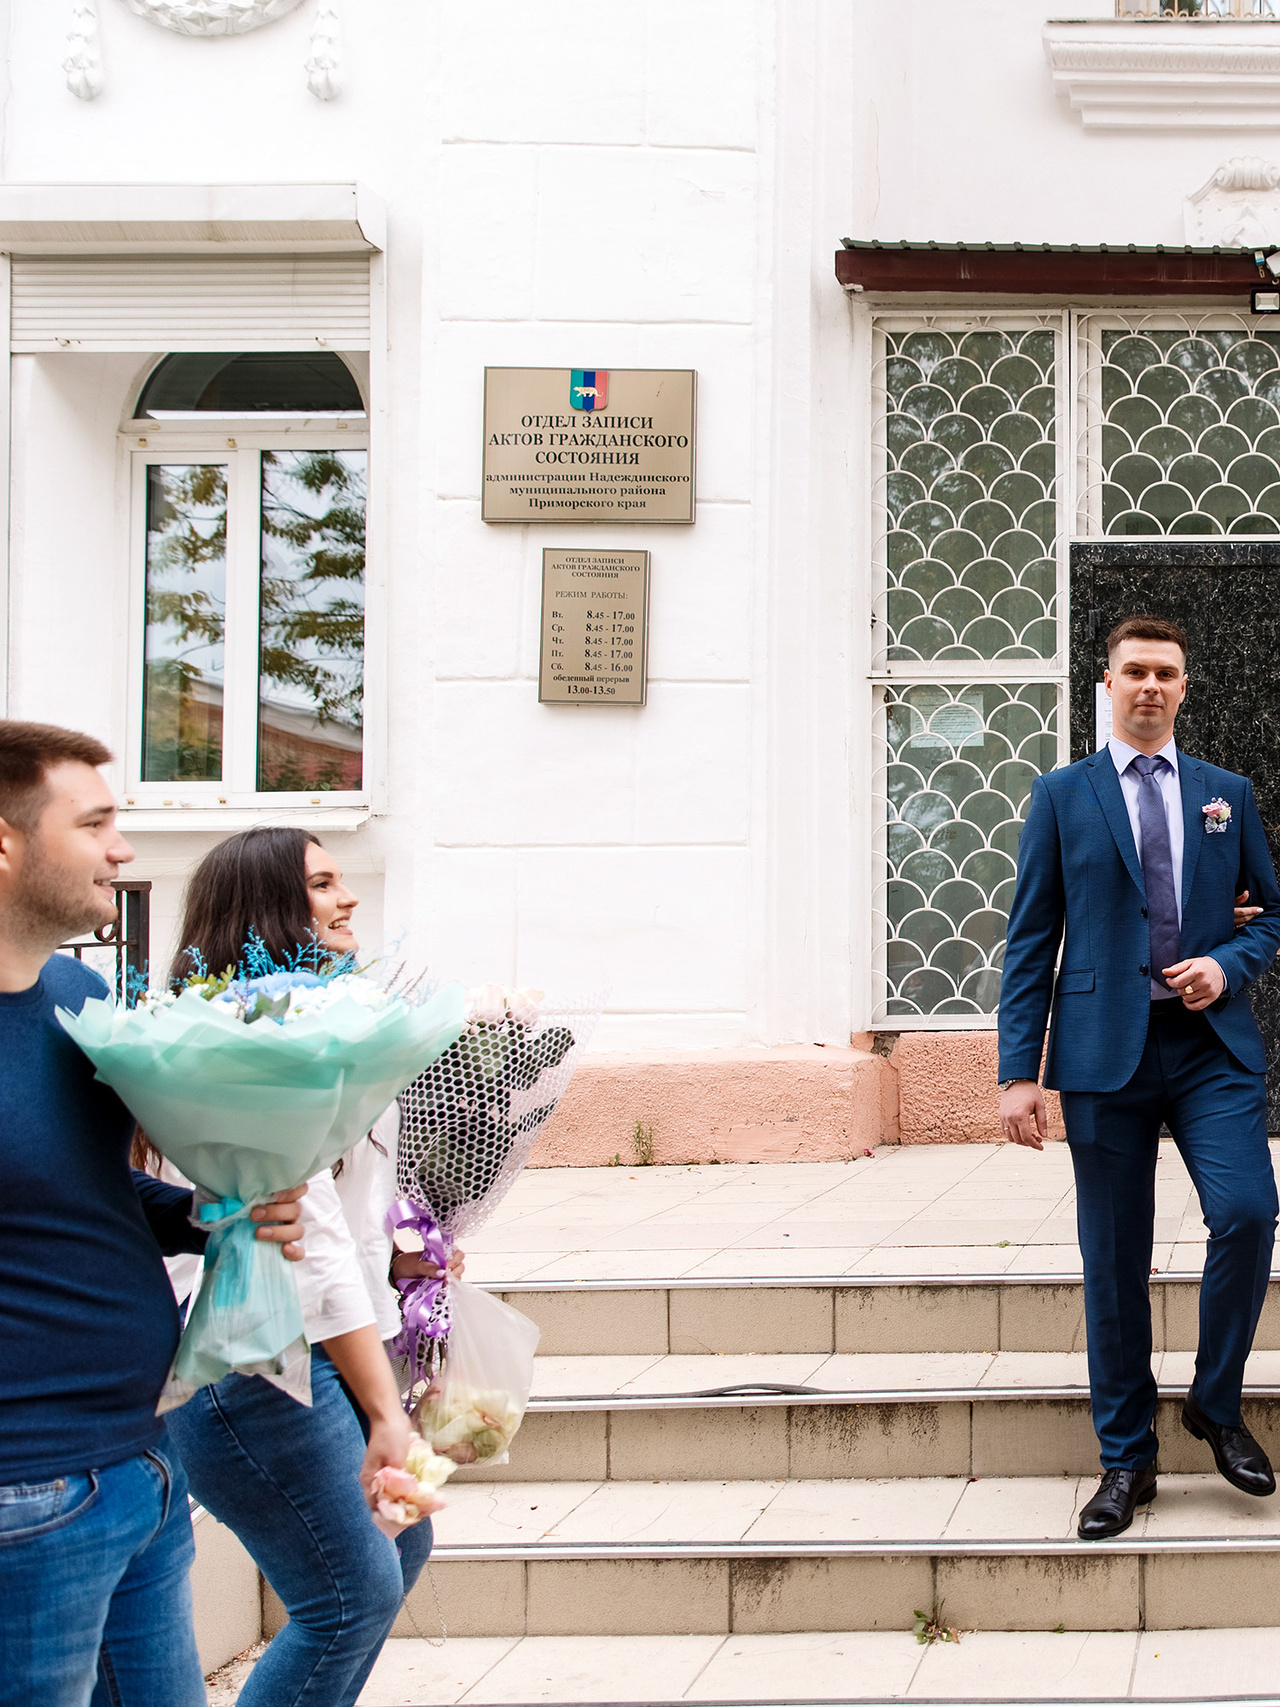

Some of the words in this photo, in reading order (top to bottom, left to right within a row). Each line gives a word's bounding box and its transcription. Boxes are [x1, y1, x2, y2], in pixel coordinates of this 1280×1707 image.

[521, 415, 576, 429] ОТДЕЛ
[582, 416, 653, 428] ЗАПИСИ
[488, 433, 543, 445] АКТОВ
[549, 434, 688, 448] ГРАЖДАНСКОГО
[535, 452, 640, 465] СОСТОЯНИЯ
[486, 473, 586, 482] администрации
[589, 473, 690, 483] Надеждинского
[509, 486, 617, 496] муниципального
[620, 486, 666, 496] района
[529, 498, 614, 509] Приморского
[617, 502, 646, 510] края
[587, 610, 604, 619] 8.45
[613, 611, 635, 620] 17.00
[552, 624, 565, 633] Ср.
[586, 623, 603, 632] 8.45
[612, 624, 634, 633] 17.00
[585, 636, 602, 645] 8.45
[611, 637, 633, 646] 17.00
[584, 649, 602, 658] 8.45
[611, 650, 633, 659] 17.00
[584, 662, 602, 671] 8.45
[611, 663, 633, 672] 16.00
[596, 676, 630, 684] перерыв
[567, 685, 615, 695] 13.00-13.50
